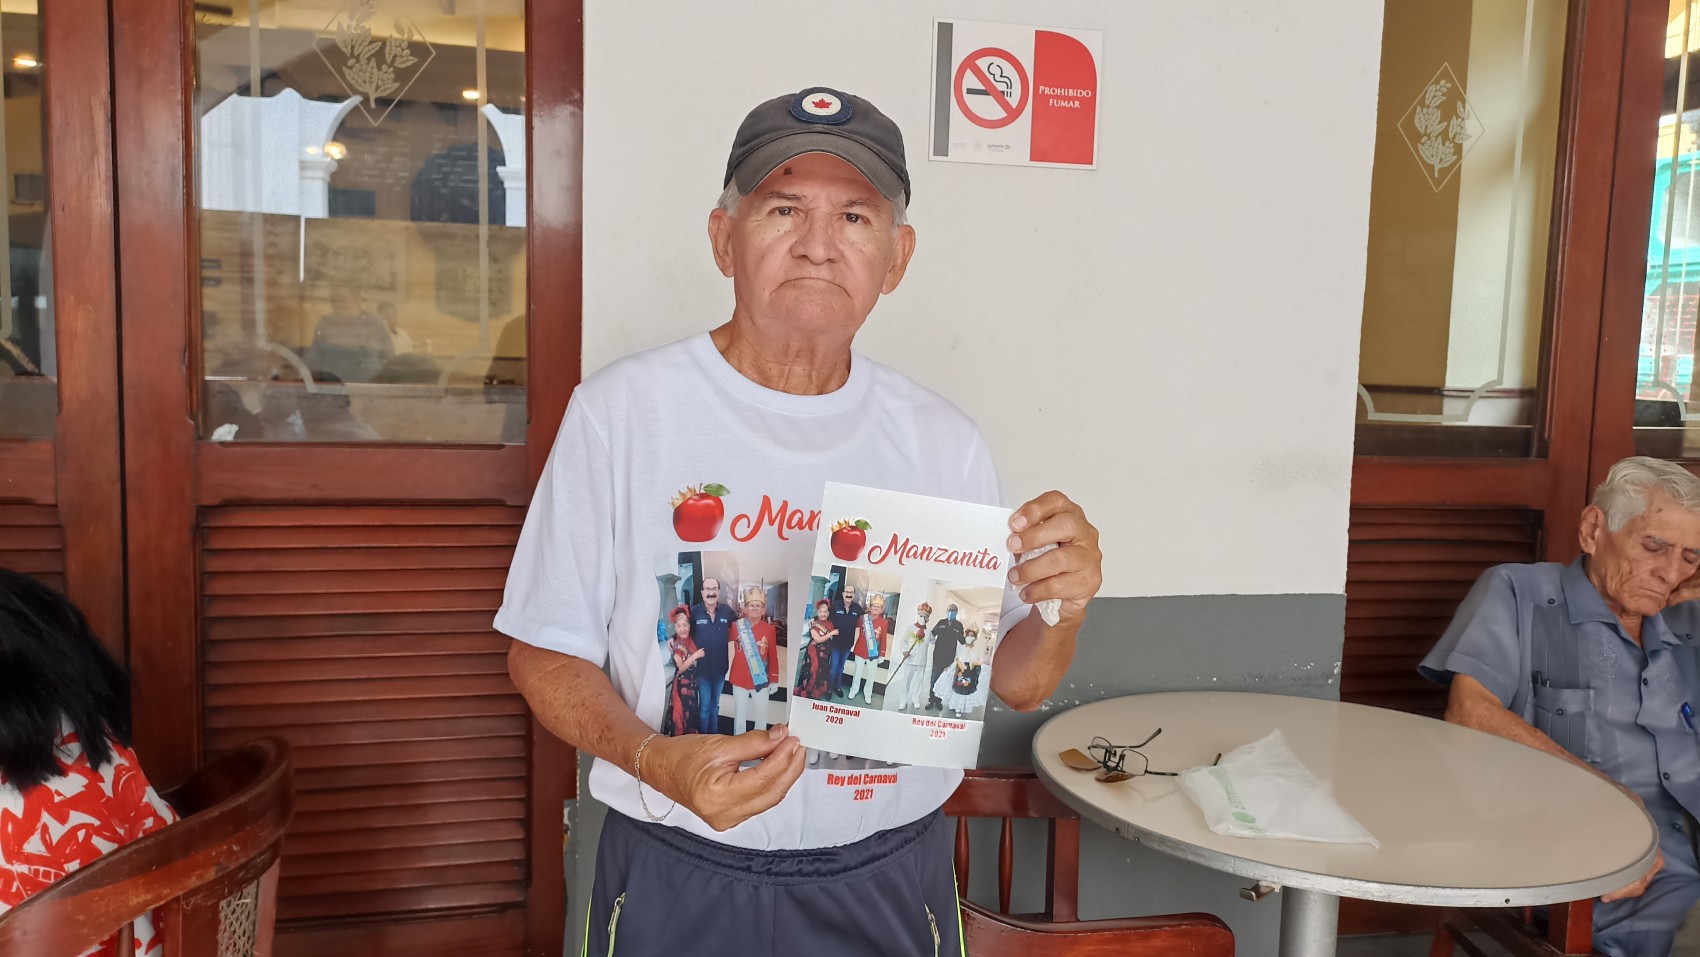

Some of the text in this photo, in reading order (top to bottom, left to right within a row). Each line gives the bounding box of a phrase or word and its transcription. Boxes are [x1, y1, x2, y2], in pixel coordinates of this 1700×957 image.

[1039, 85, 1092, 98] PROHIBIDO
[1049, 98, 1081, 108] FUMAR
[867, 532, 1002, 570] Manzanita
[811, 702, 860, 717] Juan Carnaval
[825, 715, 844, 725] 2020
[912, 717, 966, 731] Rey del Carnaval
[930, 730, 946, 738] 2021
[827, 773, 846, 786] Rey
[847, 773, 862, 785] del
[853, 788, 874, 800] 2021
